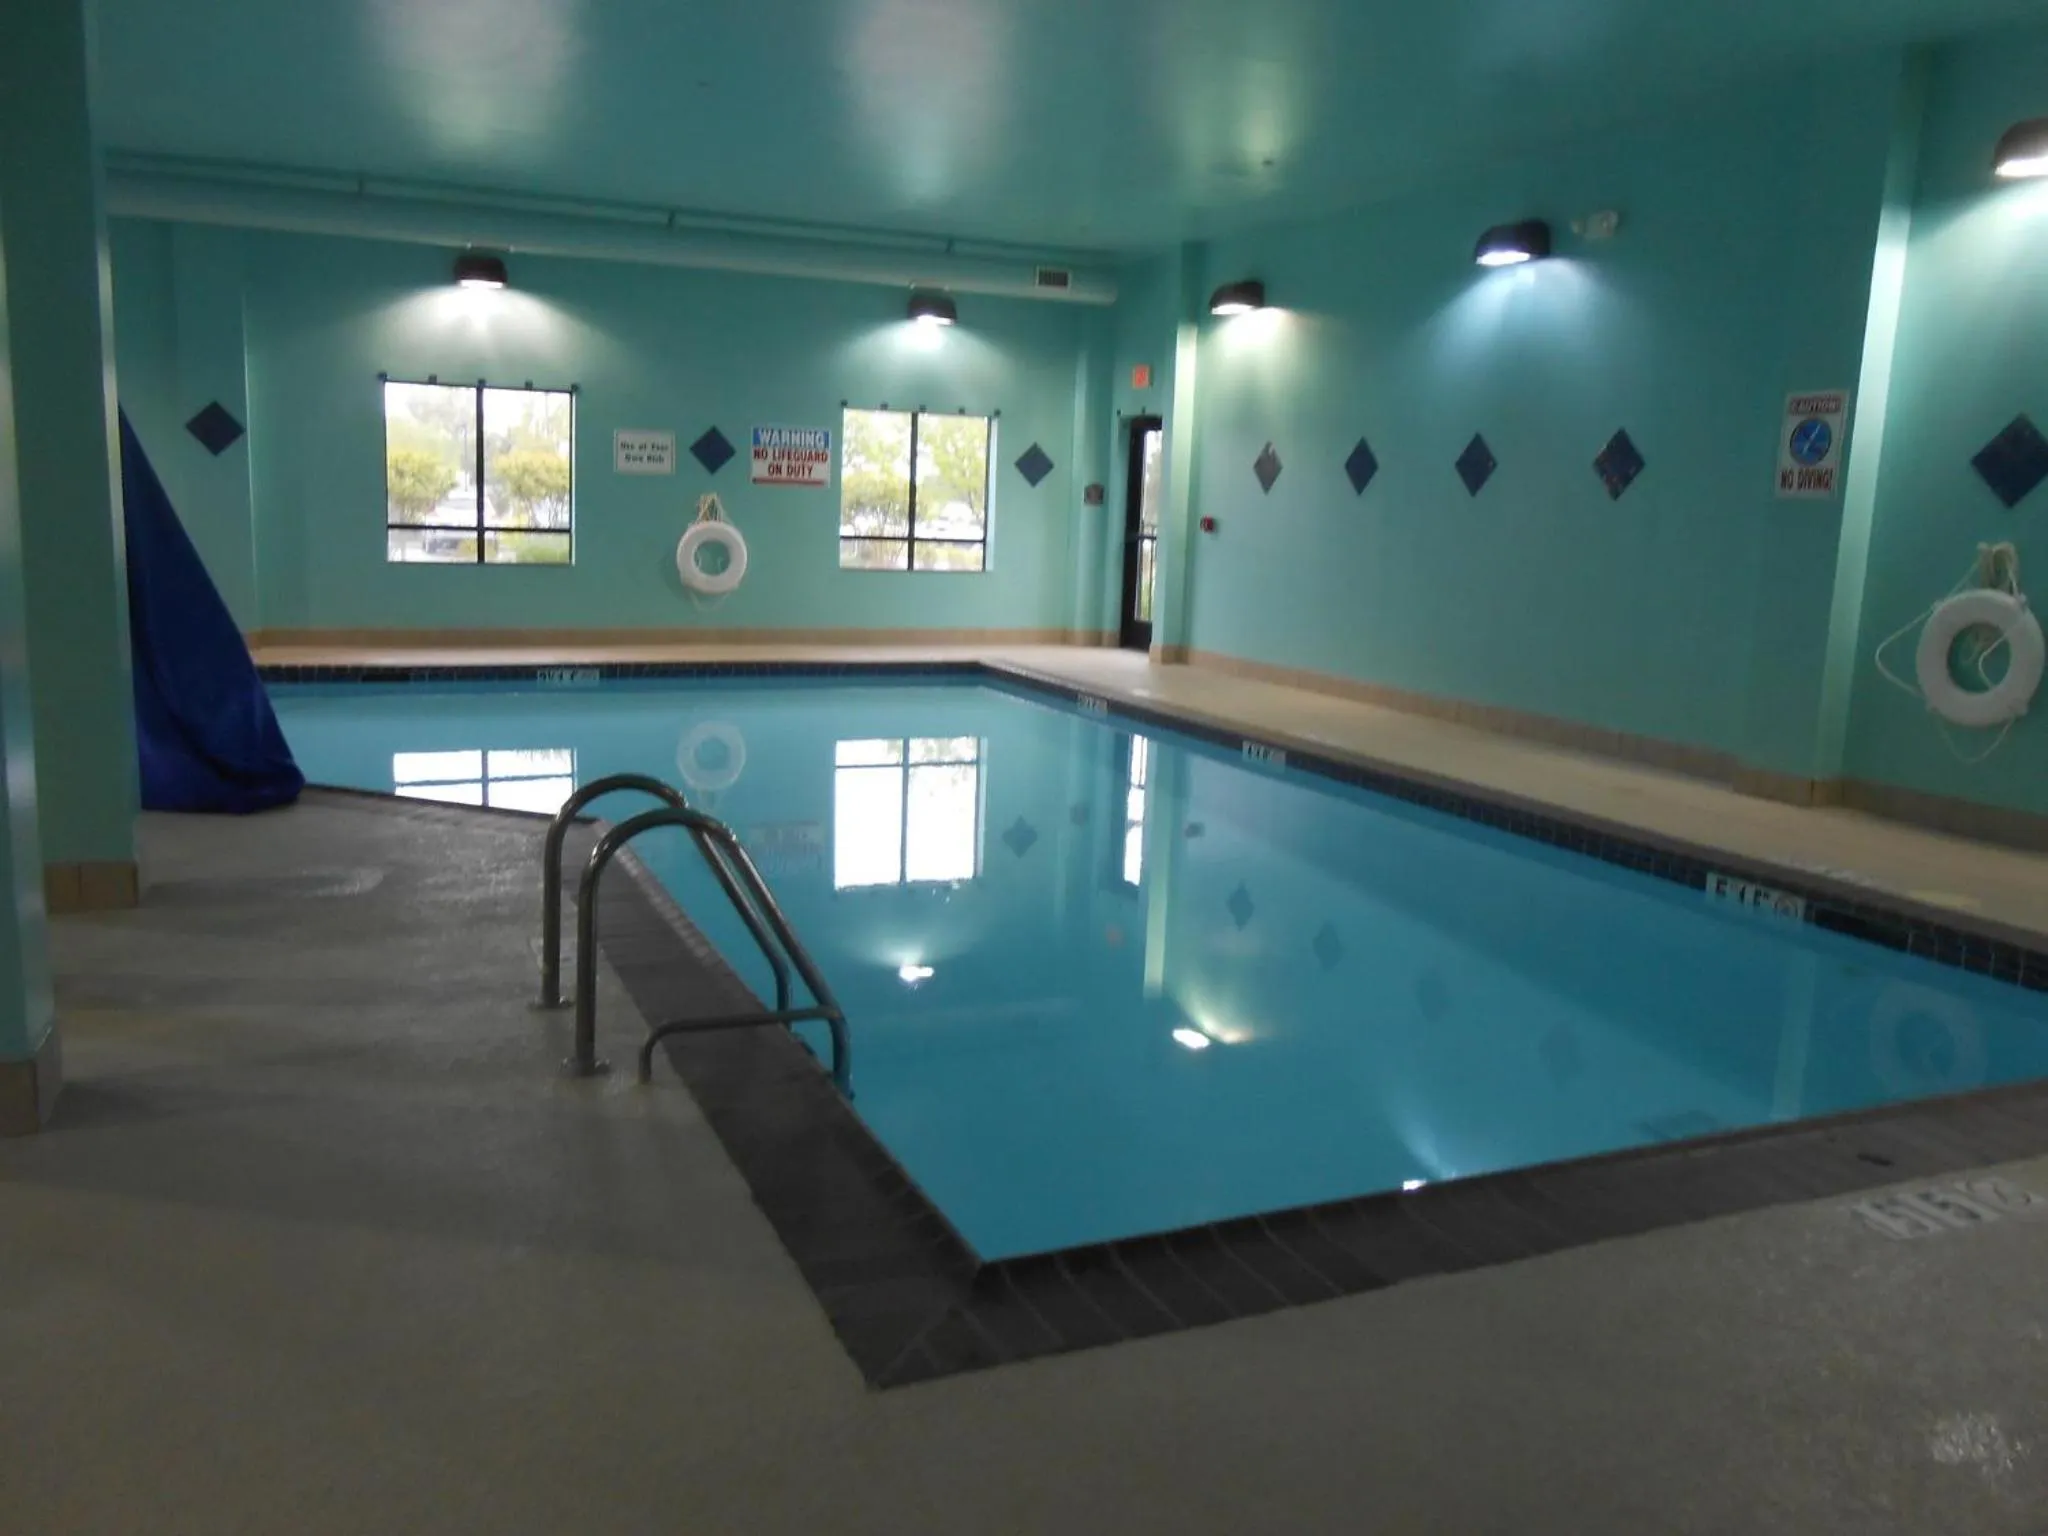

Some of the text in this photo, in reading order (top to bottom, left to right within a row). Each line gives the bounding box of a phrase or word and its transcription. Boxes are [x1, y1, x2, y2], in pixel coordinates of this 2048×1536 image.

[758, 428, 825, 448] WARNING
[753, 447, 828, 464] NO LIFEGUARD
[768, 462, 814, 477] ON DUTY
[1780, 468, 1794, 490] NO
